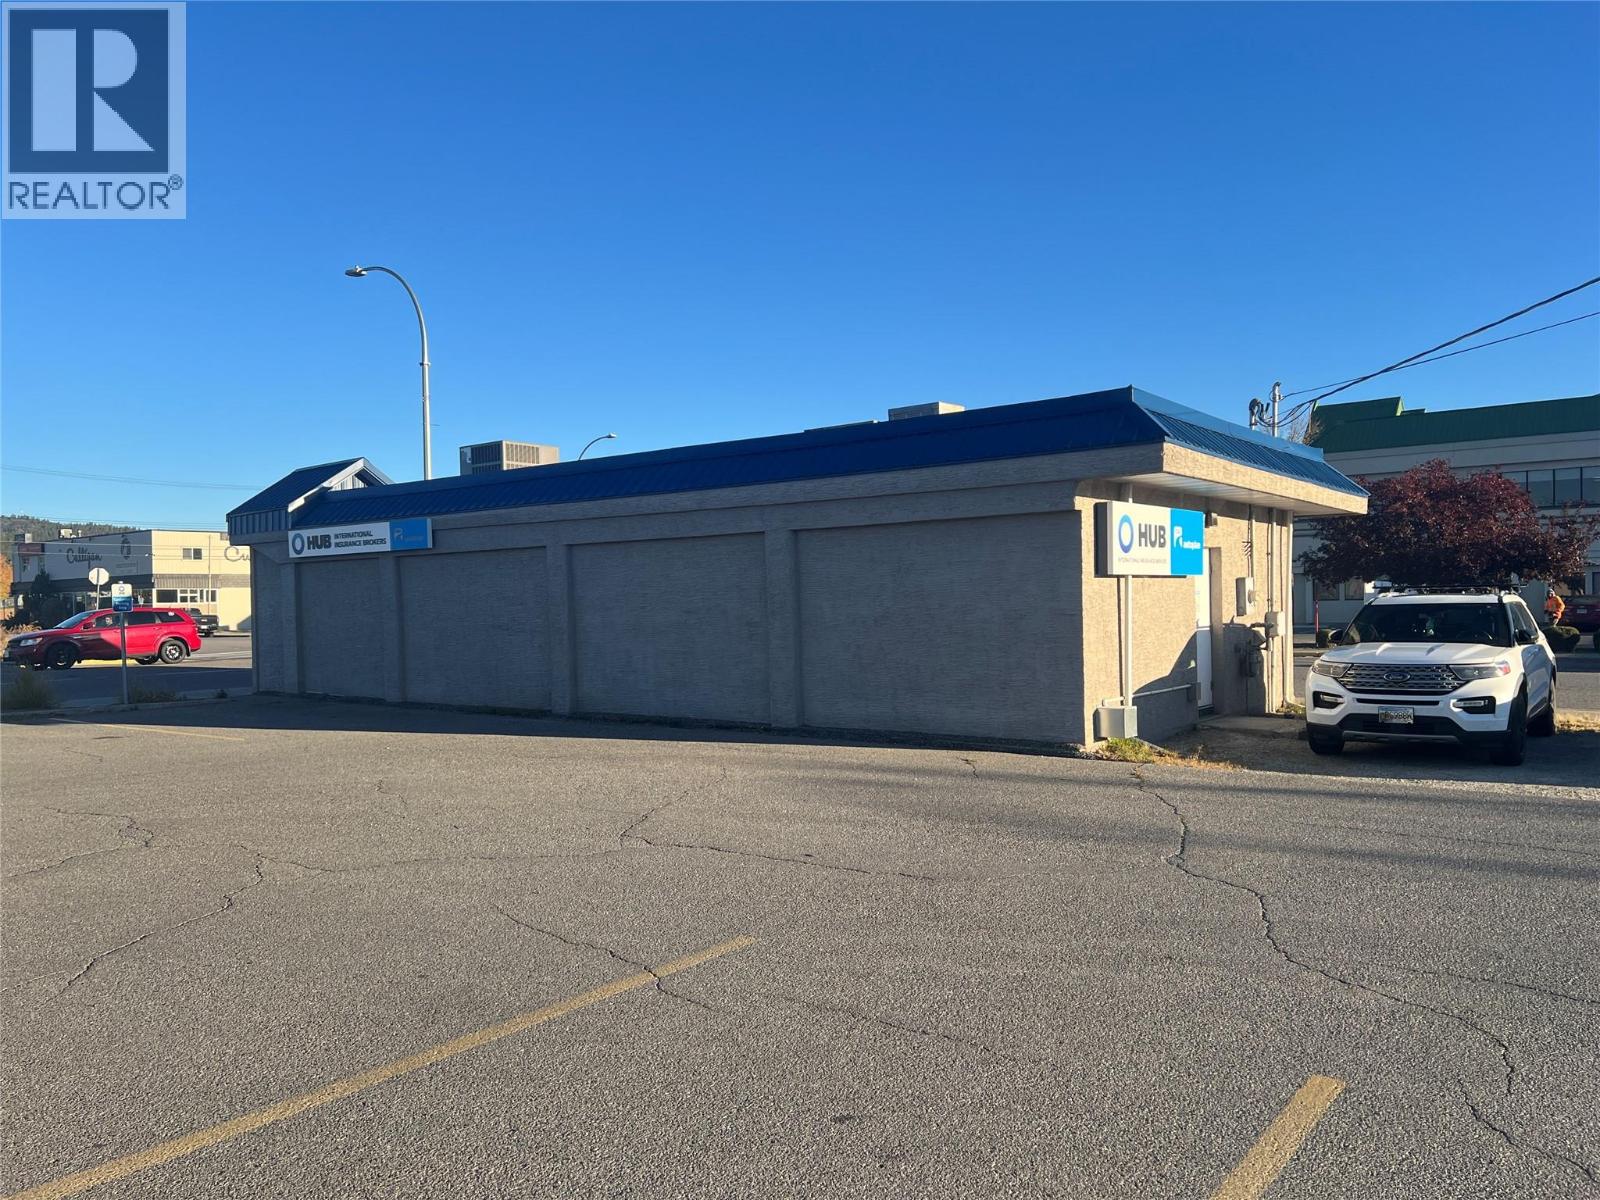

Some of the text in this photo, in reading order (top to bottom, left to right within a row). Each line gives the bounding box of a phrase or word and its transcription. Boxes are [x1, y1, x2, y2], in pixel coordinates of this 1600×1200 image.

[307, 534, 332, 550] HUB
[334, 531, 373, 540] INTERNATIONAL
[1138, 523, 1167, 548] HUB
[334, 537, 387, 548] INSURANCE BROKERS
